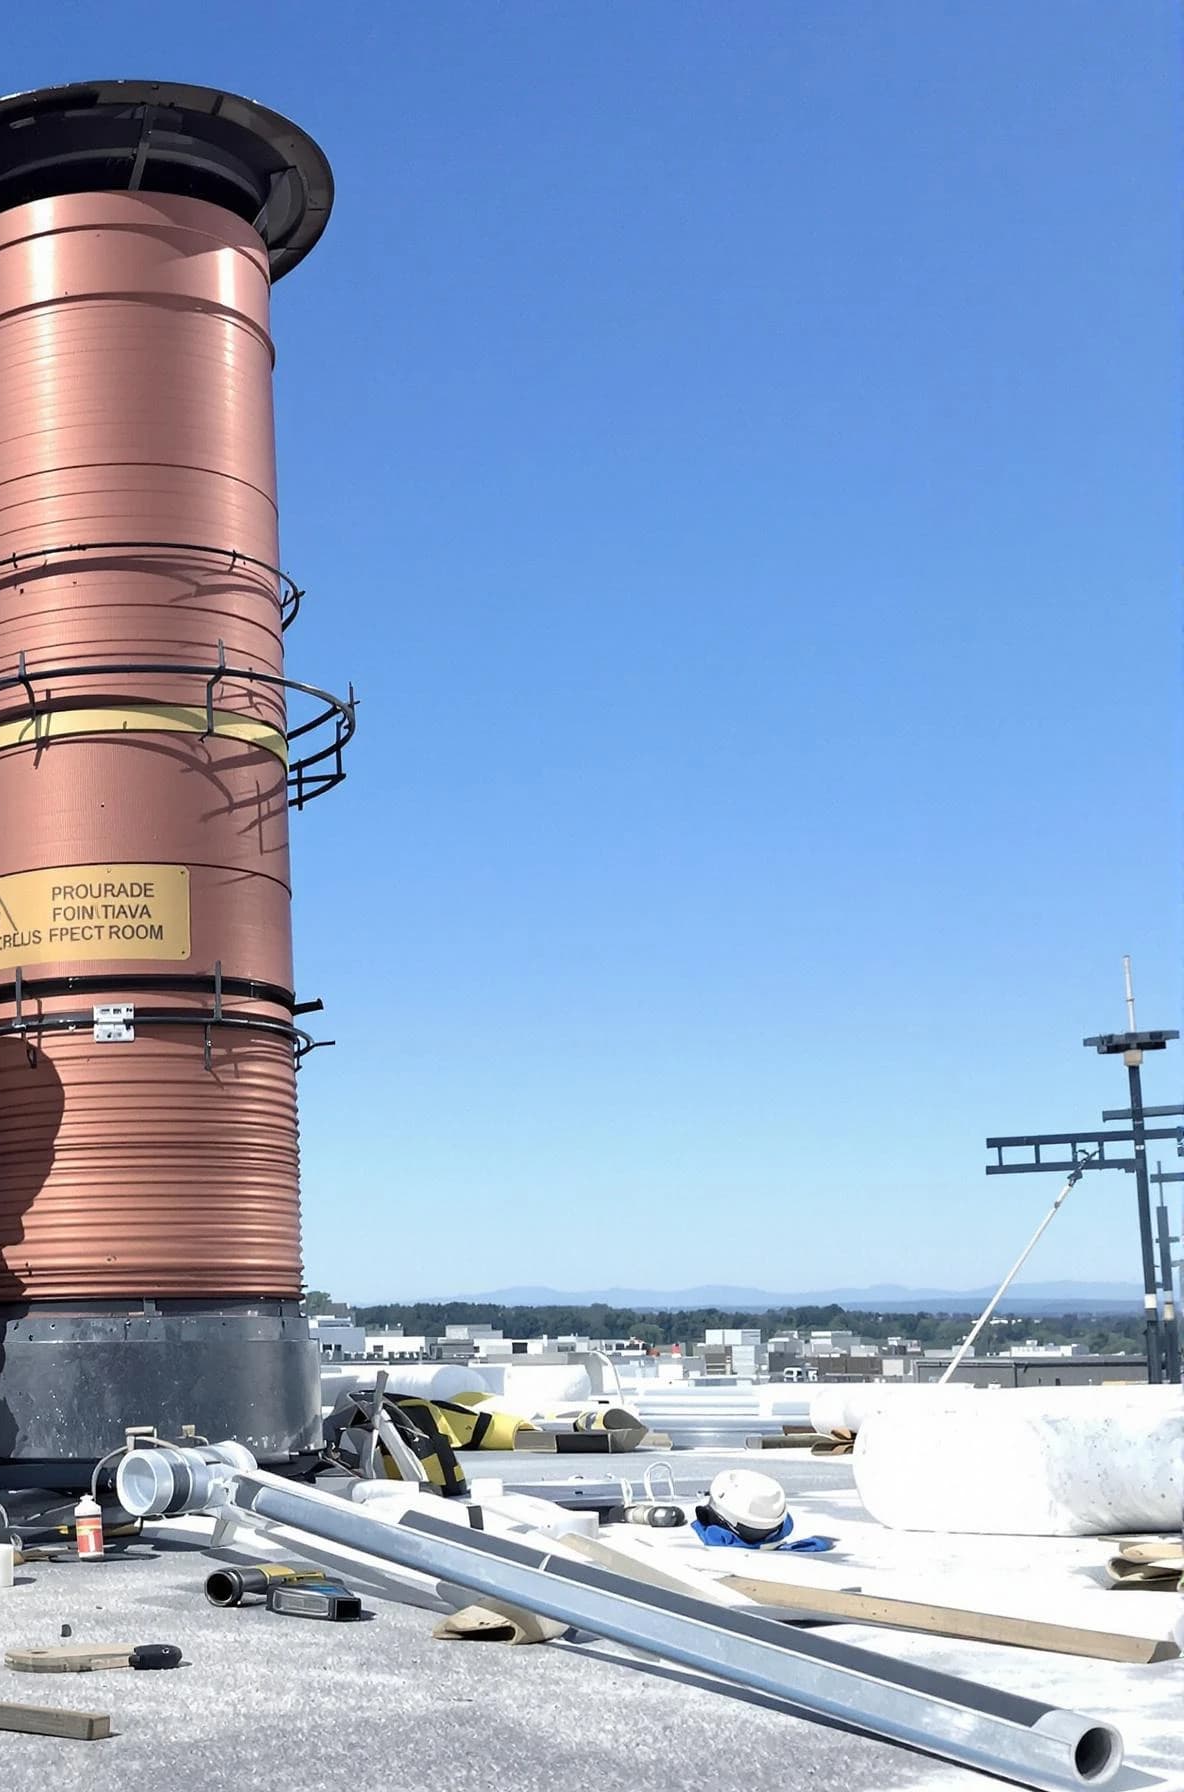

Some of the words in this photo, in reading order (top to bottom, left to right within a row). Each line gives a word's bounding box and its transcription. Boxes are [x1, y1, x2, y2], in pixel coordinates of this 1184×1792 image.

[51, 882, 155, 901] PROURADE
[49, 925, 105, 943] FPECT
[108, 924, 164, 941] ROOM
